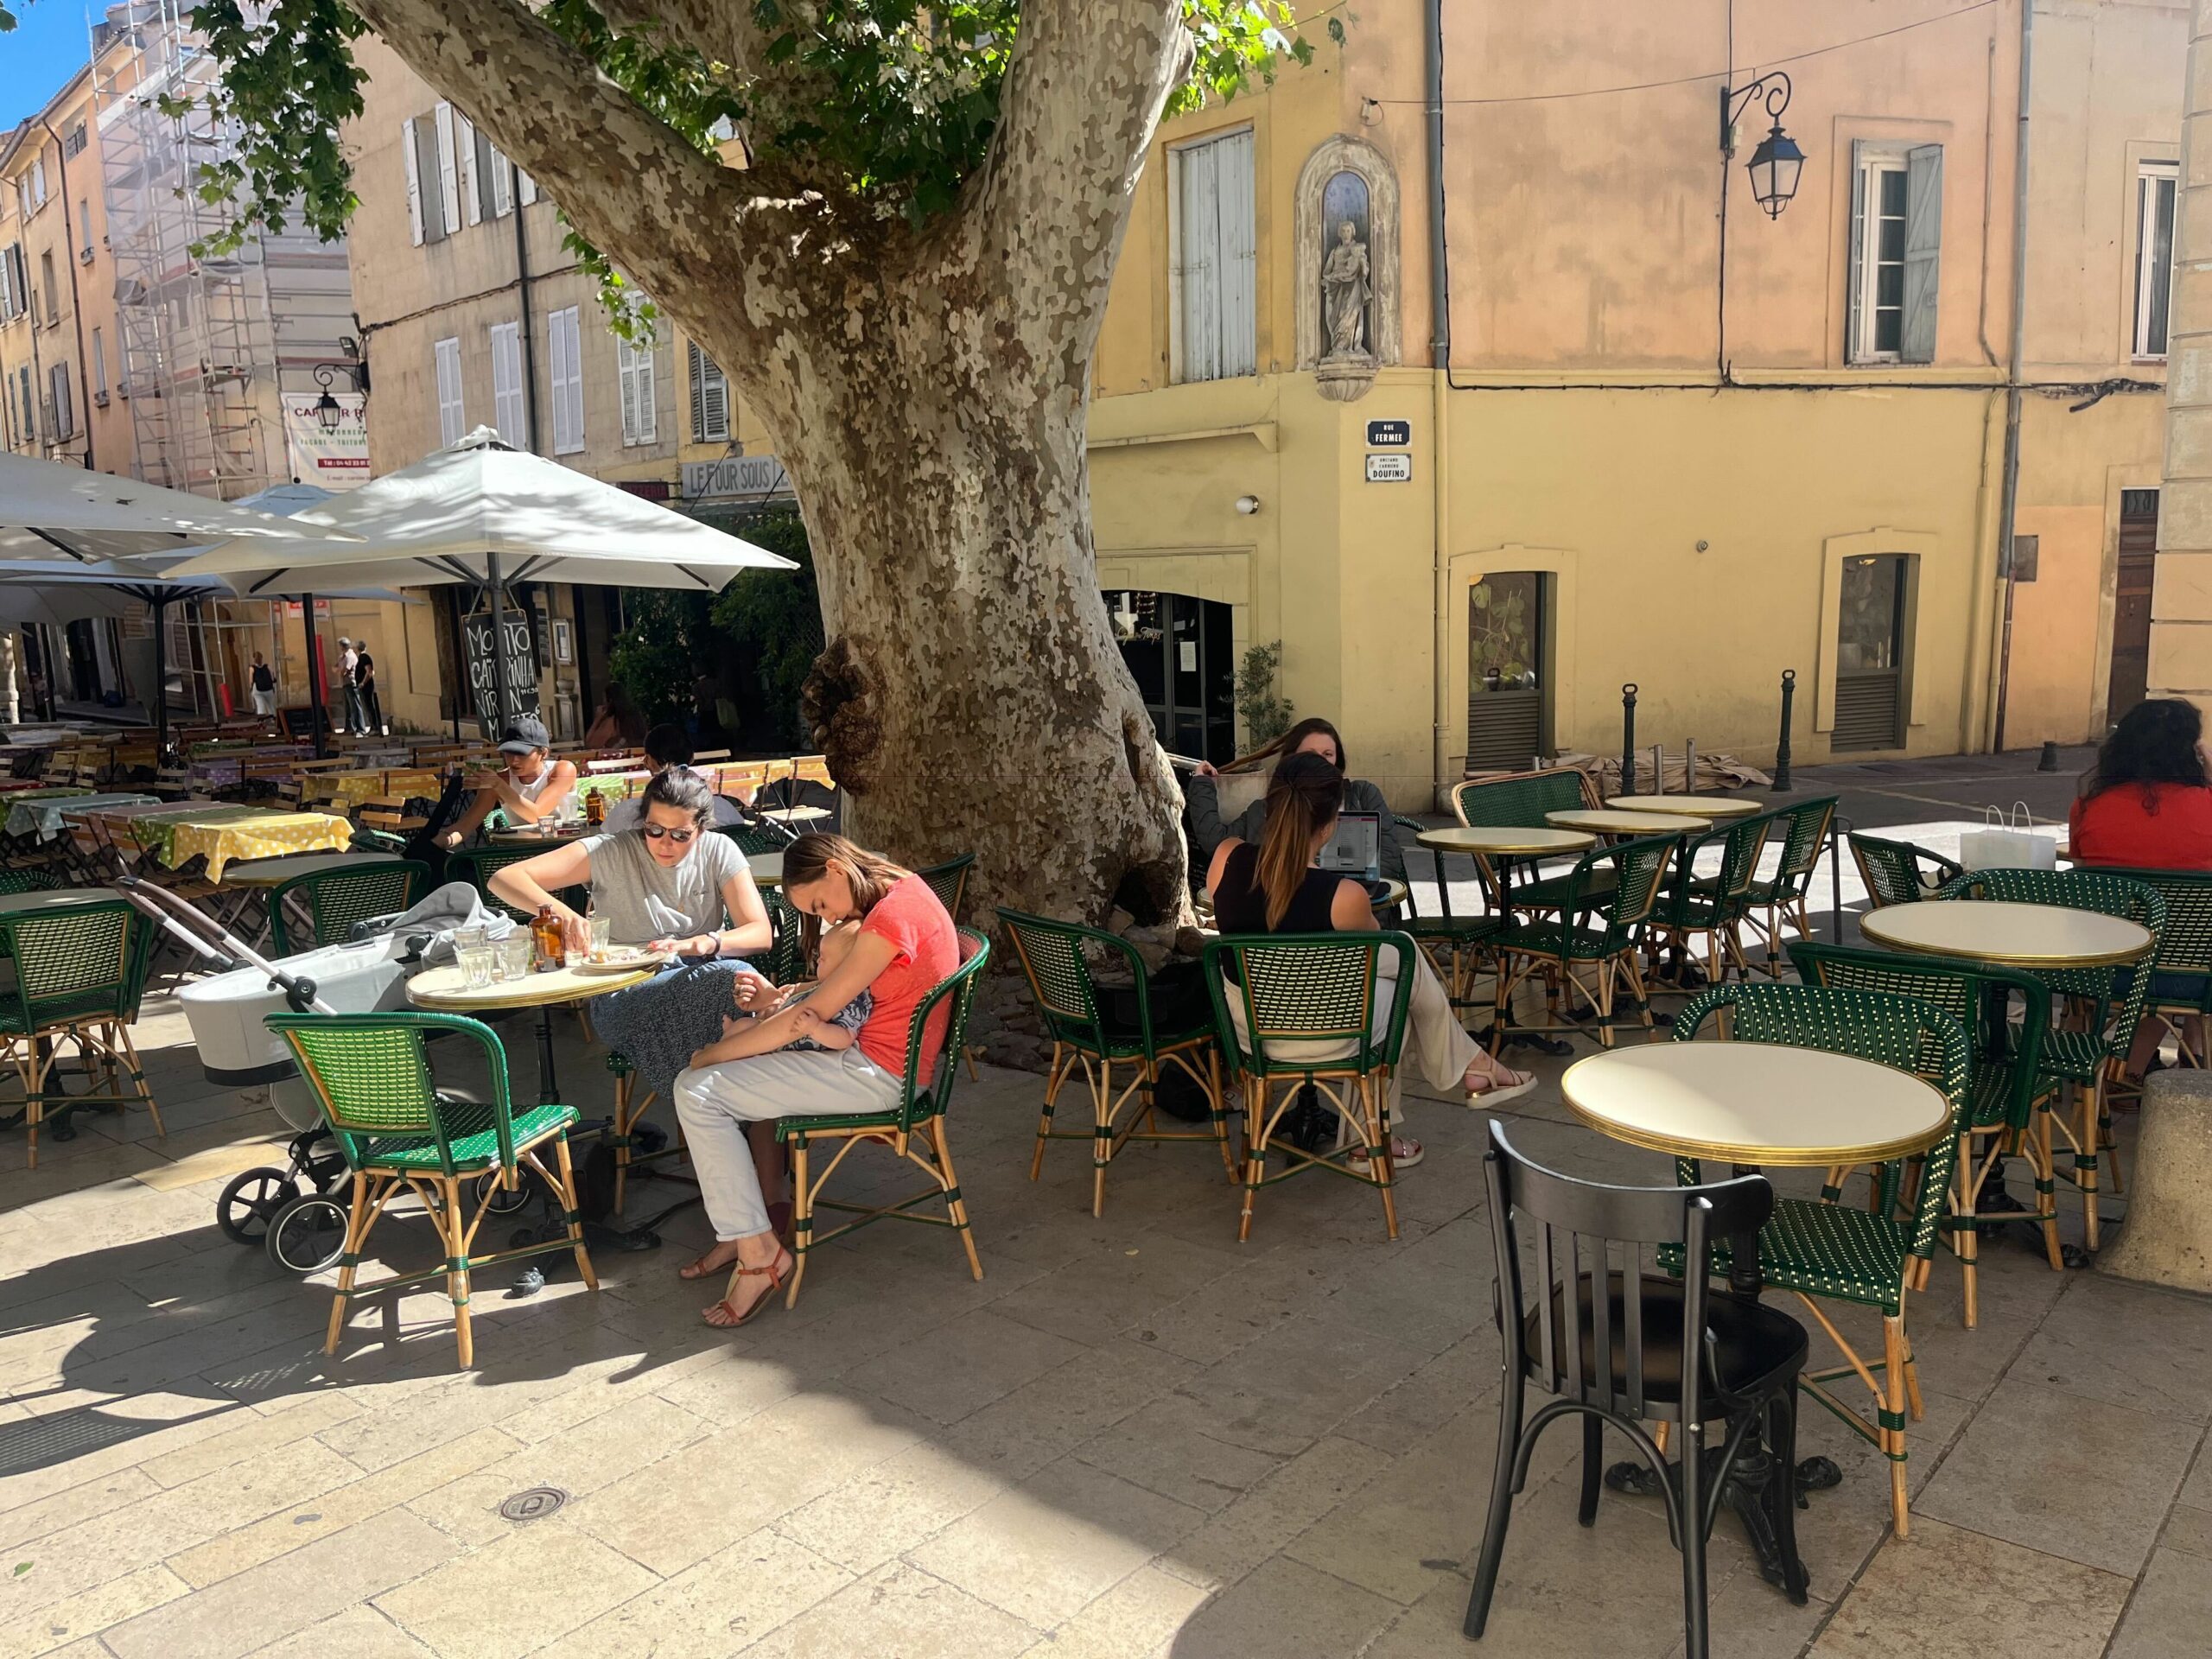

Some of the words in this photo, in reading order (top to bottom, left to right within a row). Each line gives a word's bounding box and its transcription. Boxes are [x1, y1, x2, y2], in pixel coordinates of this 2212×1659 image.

[1376, 434, 1402, 442] FERMEE
[690, 467, 704, 494] LE
[706, 463, 738, 494] FOUR
[741, 461, 769, 490] SOUS
[1373, 469, 1405, 478] DOUFINO
[467, 622, 531, 658] MOITO
[476, 688, 523, 719] VIRN
